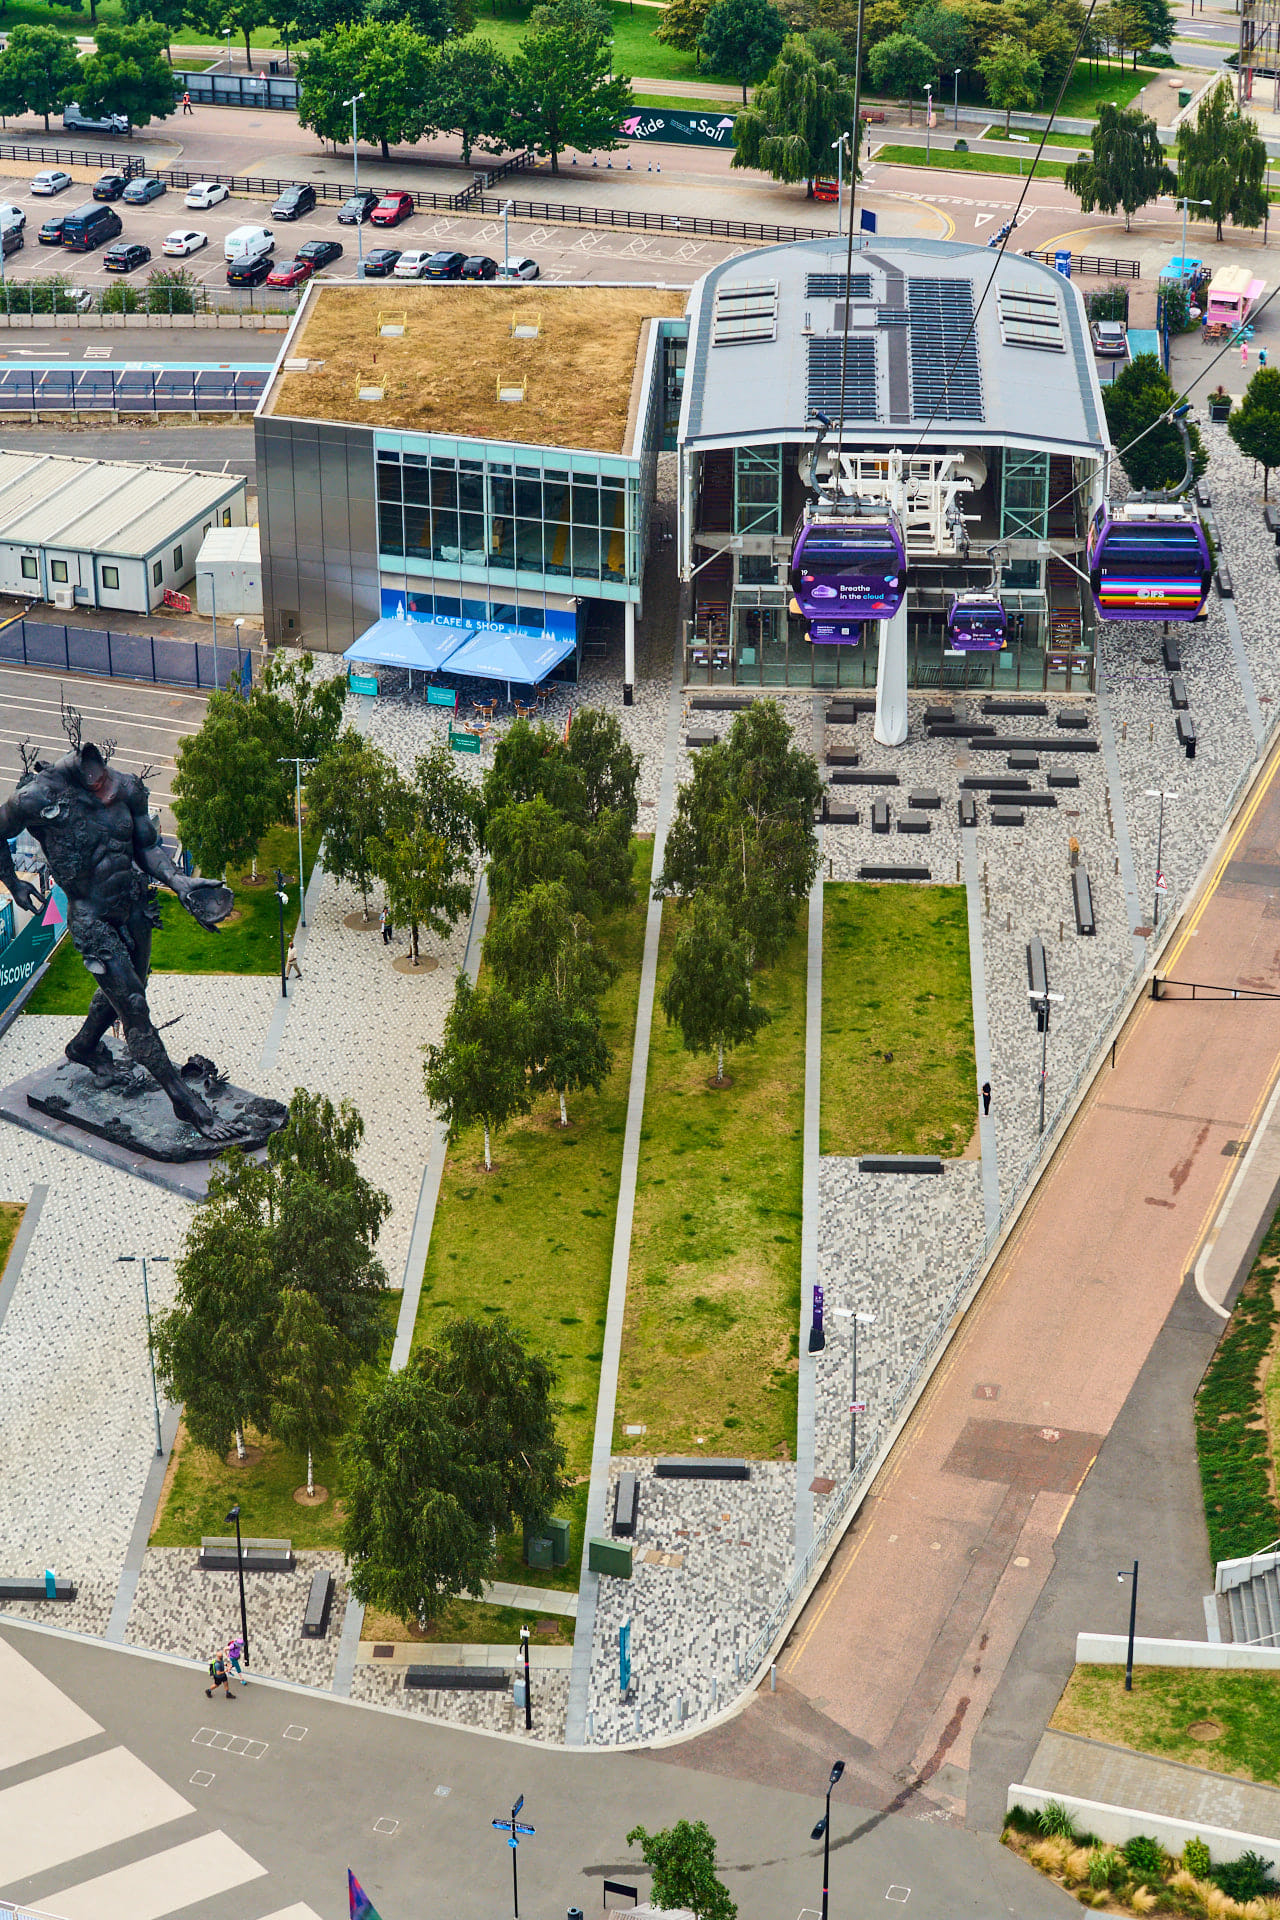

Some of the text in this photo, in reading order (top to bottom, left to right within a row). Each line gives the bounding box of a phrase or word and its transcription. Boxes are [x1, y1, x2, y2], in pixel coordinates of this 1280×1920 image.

[634, 118, 665, 139] Ride
[697, 119, 725, 141] Sail
[435, 615, 505, 632] CAFE & SHOP
[0, 961, 35, 986] iscover
